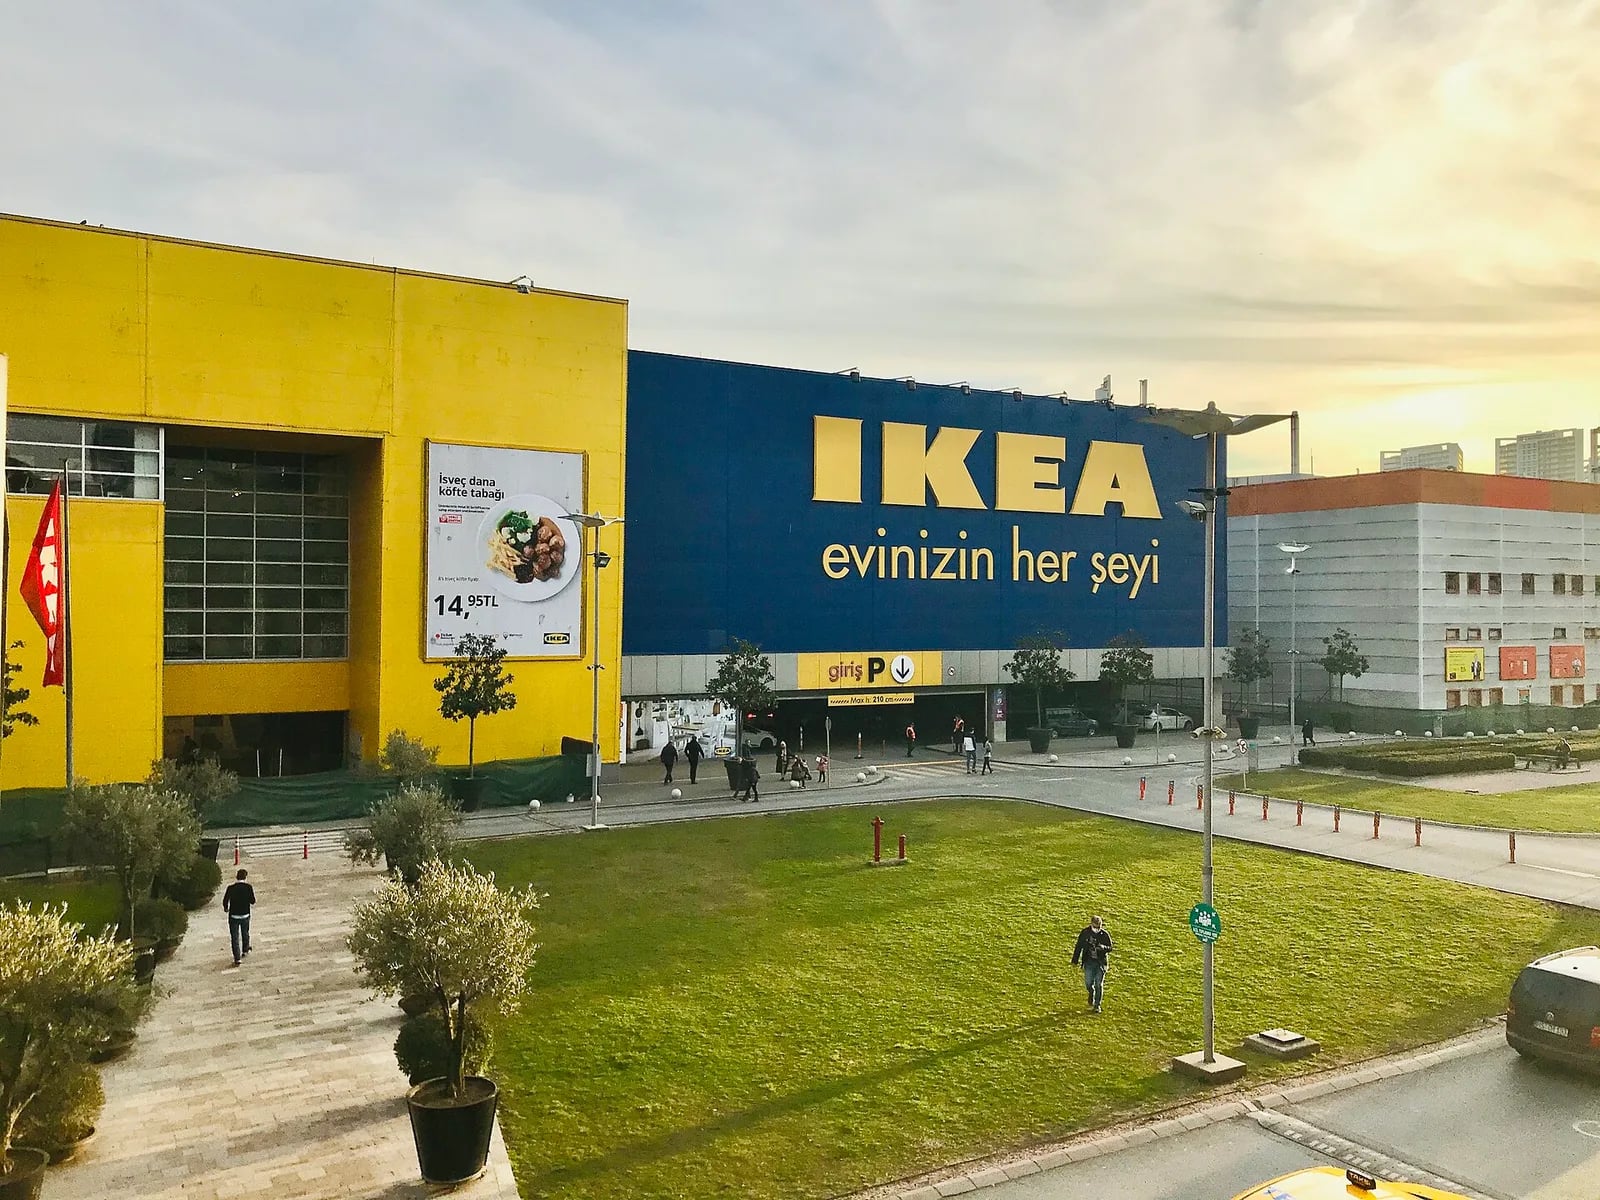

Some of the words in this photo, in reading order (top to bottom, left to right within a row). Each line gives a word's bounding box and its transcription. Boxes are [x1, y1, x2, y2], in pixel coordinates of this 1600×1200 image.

[812, 415, 1163, 519] IKEA
[439, 472, 467, 487] İsveç
[469, 476, 496, 487] dana
[439, 486, 468, 497] köfte
[470, 488, 505, 501] tabağı
[822, 527, 994, 580] evinizin
[1012, 525, 1077, 582] her
[1090, 538, 1160, 599] şeyi
[545, 634, 569, 642] IKEA
[828, 661, 863, 682] giriş
[868, 658, 885, 683] P
[850, 696, 865, 704] Max
